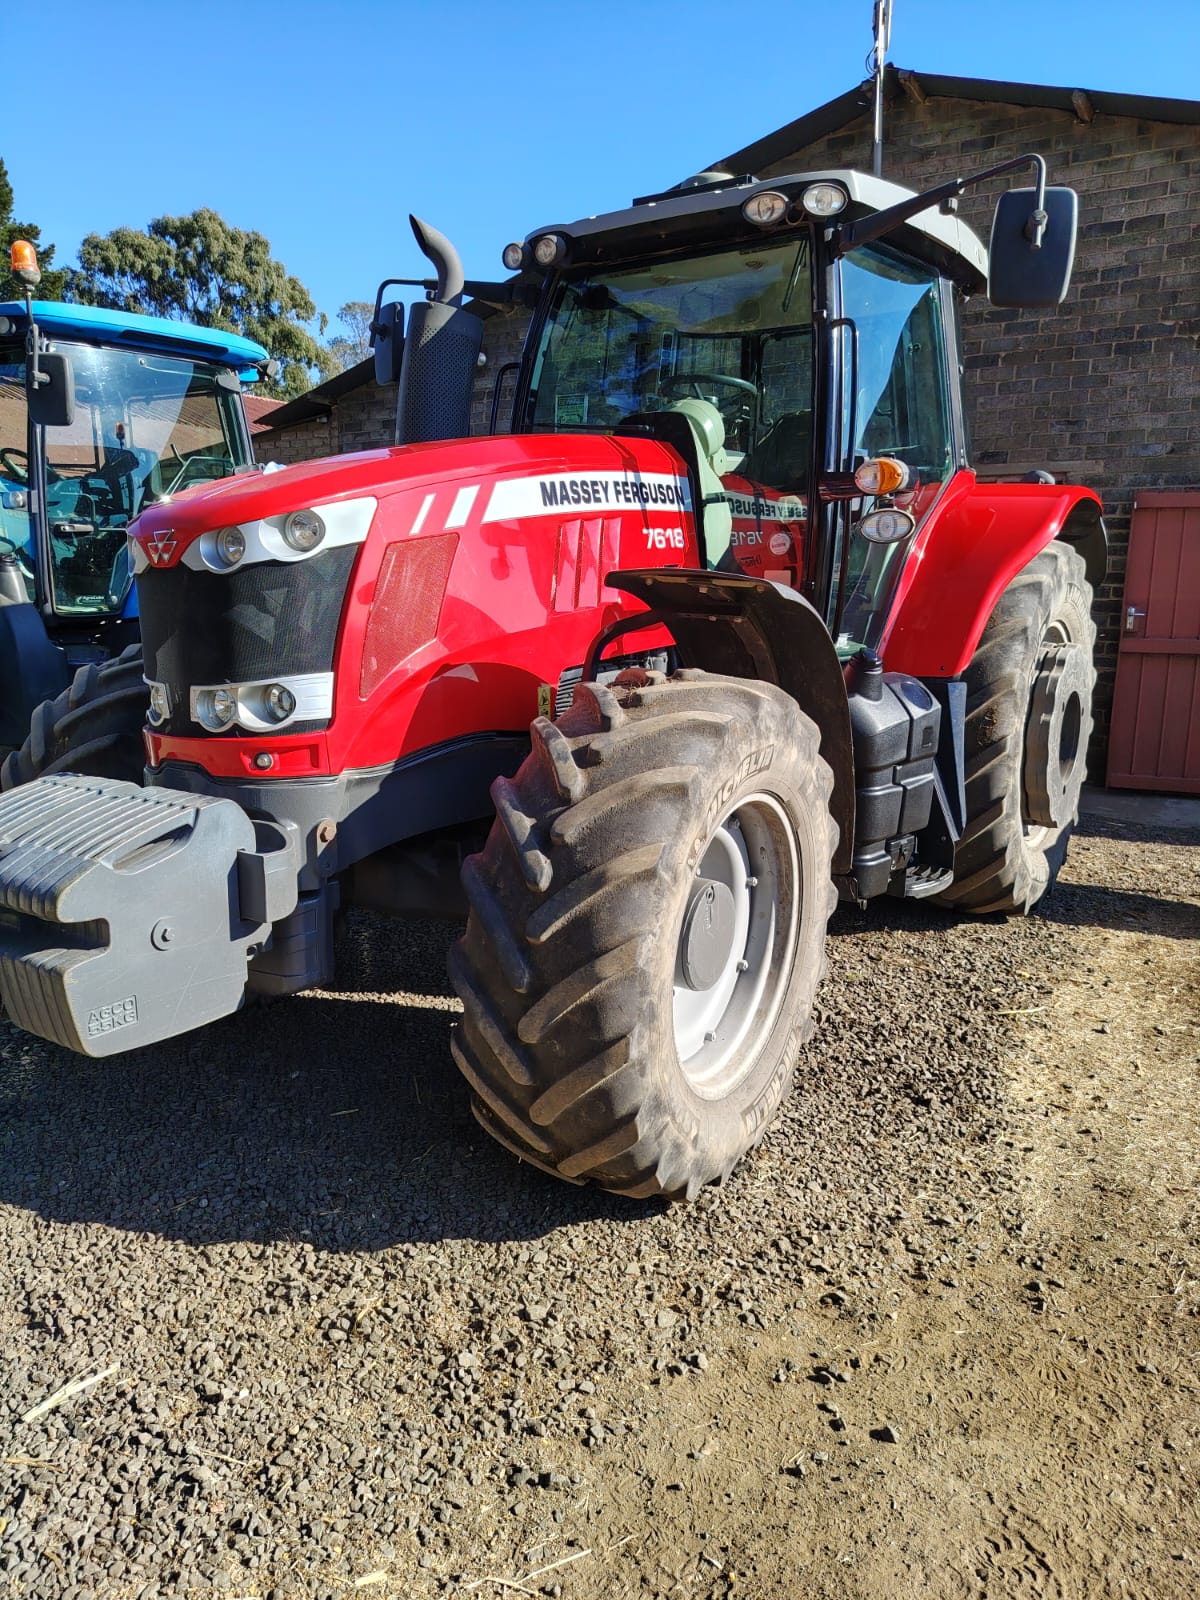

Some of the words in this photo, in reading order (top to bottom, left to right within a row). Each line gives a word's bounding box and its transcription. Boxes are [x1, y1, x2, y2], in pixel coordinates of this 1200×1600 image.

[540, 480, 609, 507] MASSEY
[613, 480, 686, 506] FERGUSON
[642, 527, 685, 550] 7618
[705, 744, 775, 833] MICHELIN
[88, 998, 134, 1025] AGCO
[88, 1010, 134, 1036] 55KG
[743, 1028, 799, 1136] MICHELIN
